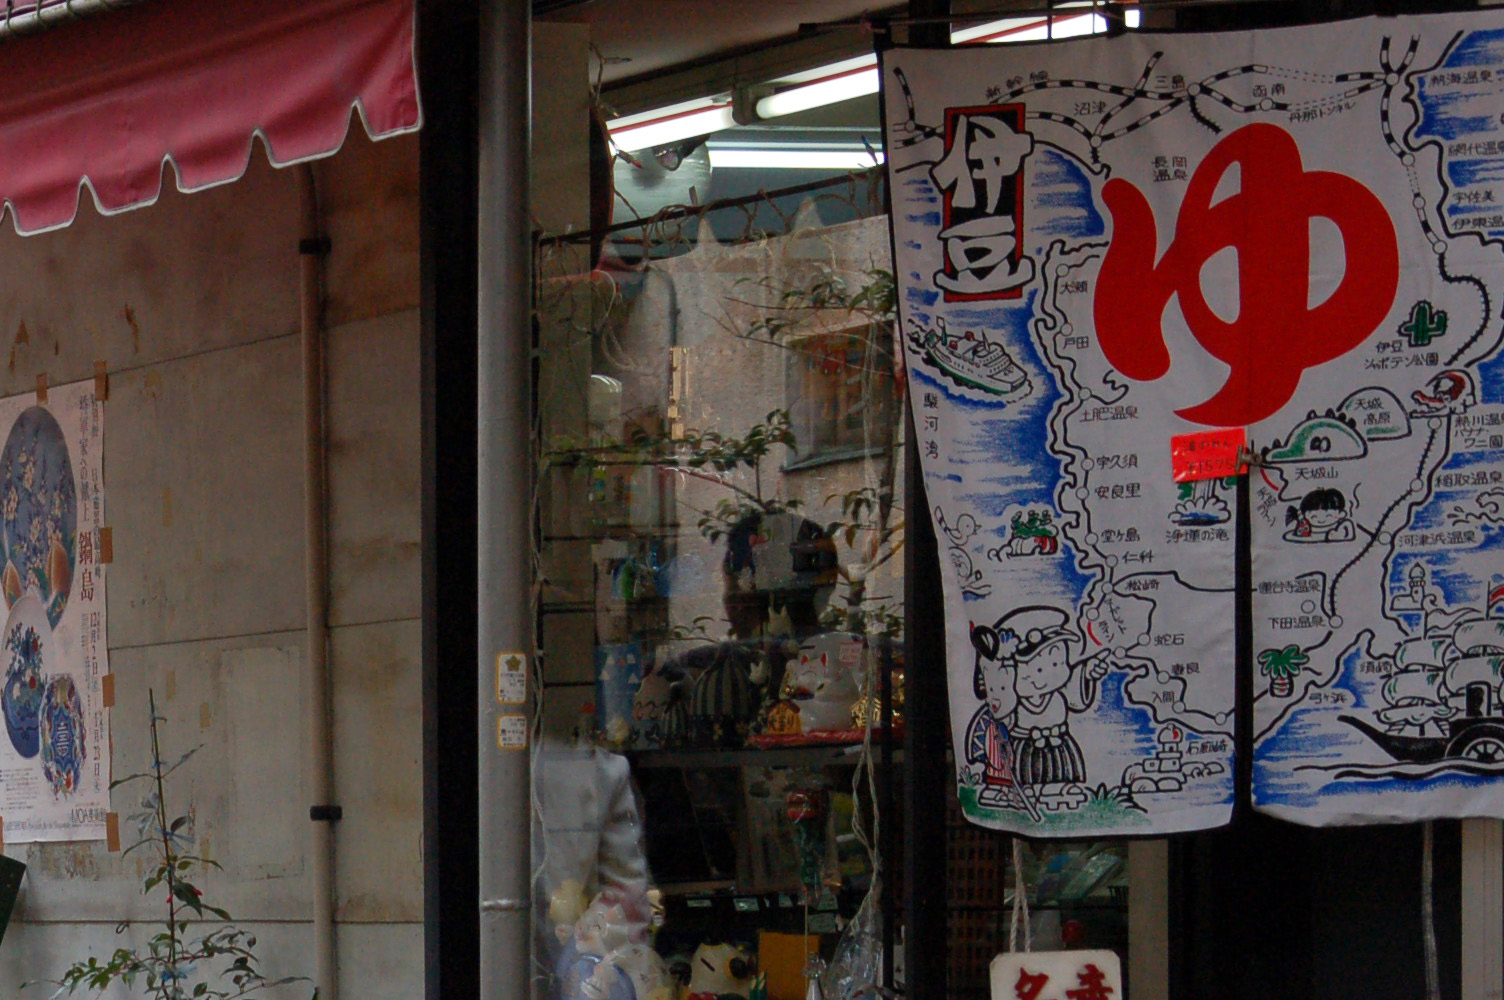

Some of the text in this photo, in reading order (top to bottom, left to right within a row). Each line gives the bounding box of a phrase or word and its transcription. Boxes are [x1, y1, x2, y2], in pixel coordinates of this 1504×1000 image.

[1155, 74, 1185, 89] 三島
[1073, 101, 1107, 116] 沼津
[930, 113, 1036, 294] 伊豆
[1453, 190, 1495, 204] 宇佐美
[1093, 123, 1399, 426] ゆ
[1063, 336, 1089, 349] 戸田
[1376, 340, 1403, 353] 伊豆
[1354, 397, 1384, 411] 天城
[1079, 405, 1139, 422] 土肥温泉
[1364, 411, 1391, 425] 高原
[923, 393, 939, 459] 駿河湾
[1096, 454, 1139, 469] 宇久須
[1295, 466, 1339, 480] 天城山
[1435, 471, 1502, 487] 稲取温泉
[1095, 482, 1141, 499] 安良里
[1100, 527, 1141, 543] 堂ヶ島
[1166, 528, 1229, 544] 浄蓮の滝
[1122, 549, 1154, 563] 仁科
[79, 531, 94, 602] 鍋島
[1268, 615, 1327, 629] 下田温泉
